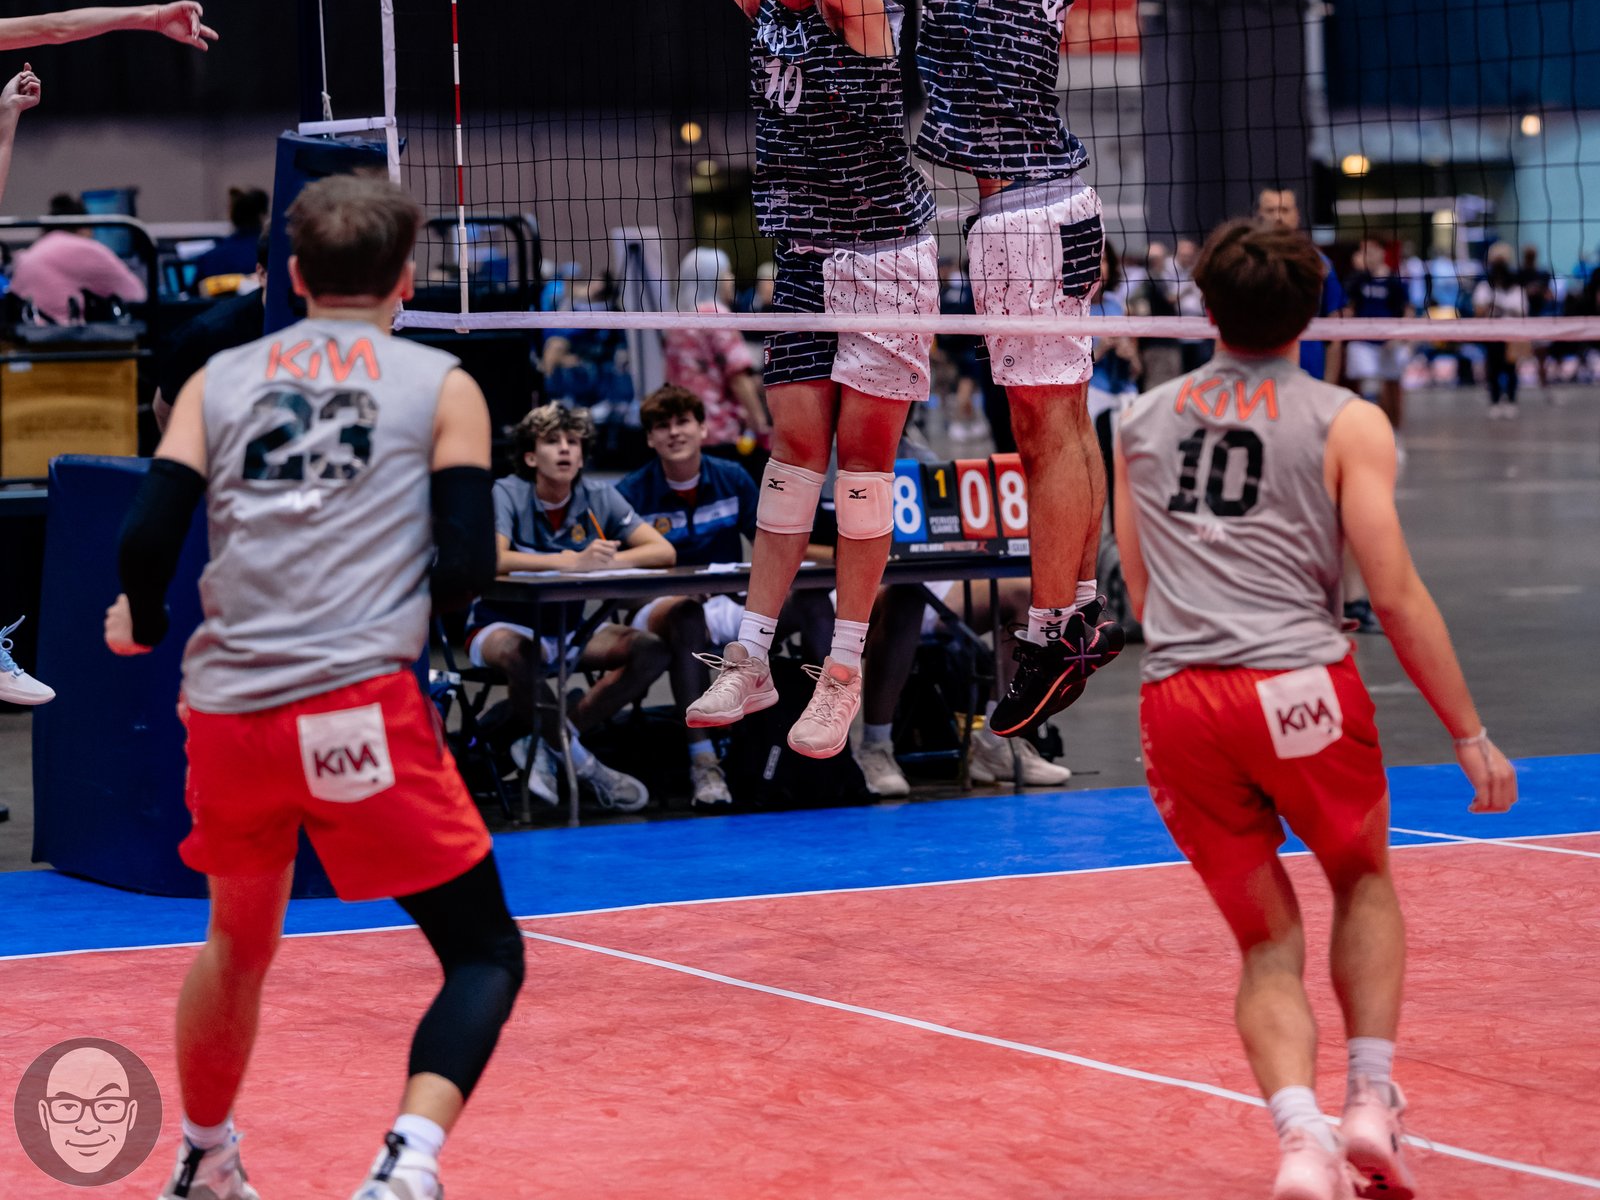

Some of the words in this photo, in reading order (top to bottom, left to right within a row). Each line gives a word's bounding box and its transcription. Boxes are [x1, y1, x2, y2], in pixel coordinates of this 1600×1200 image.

[242, 390, 380, 480] 23
[1168, 428, 1263, 517] 10
[934, 469, 947, 498] 1
